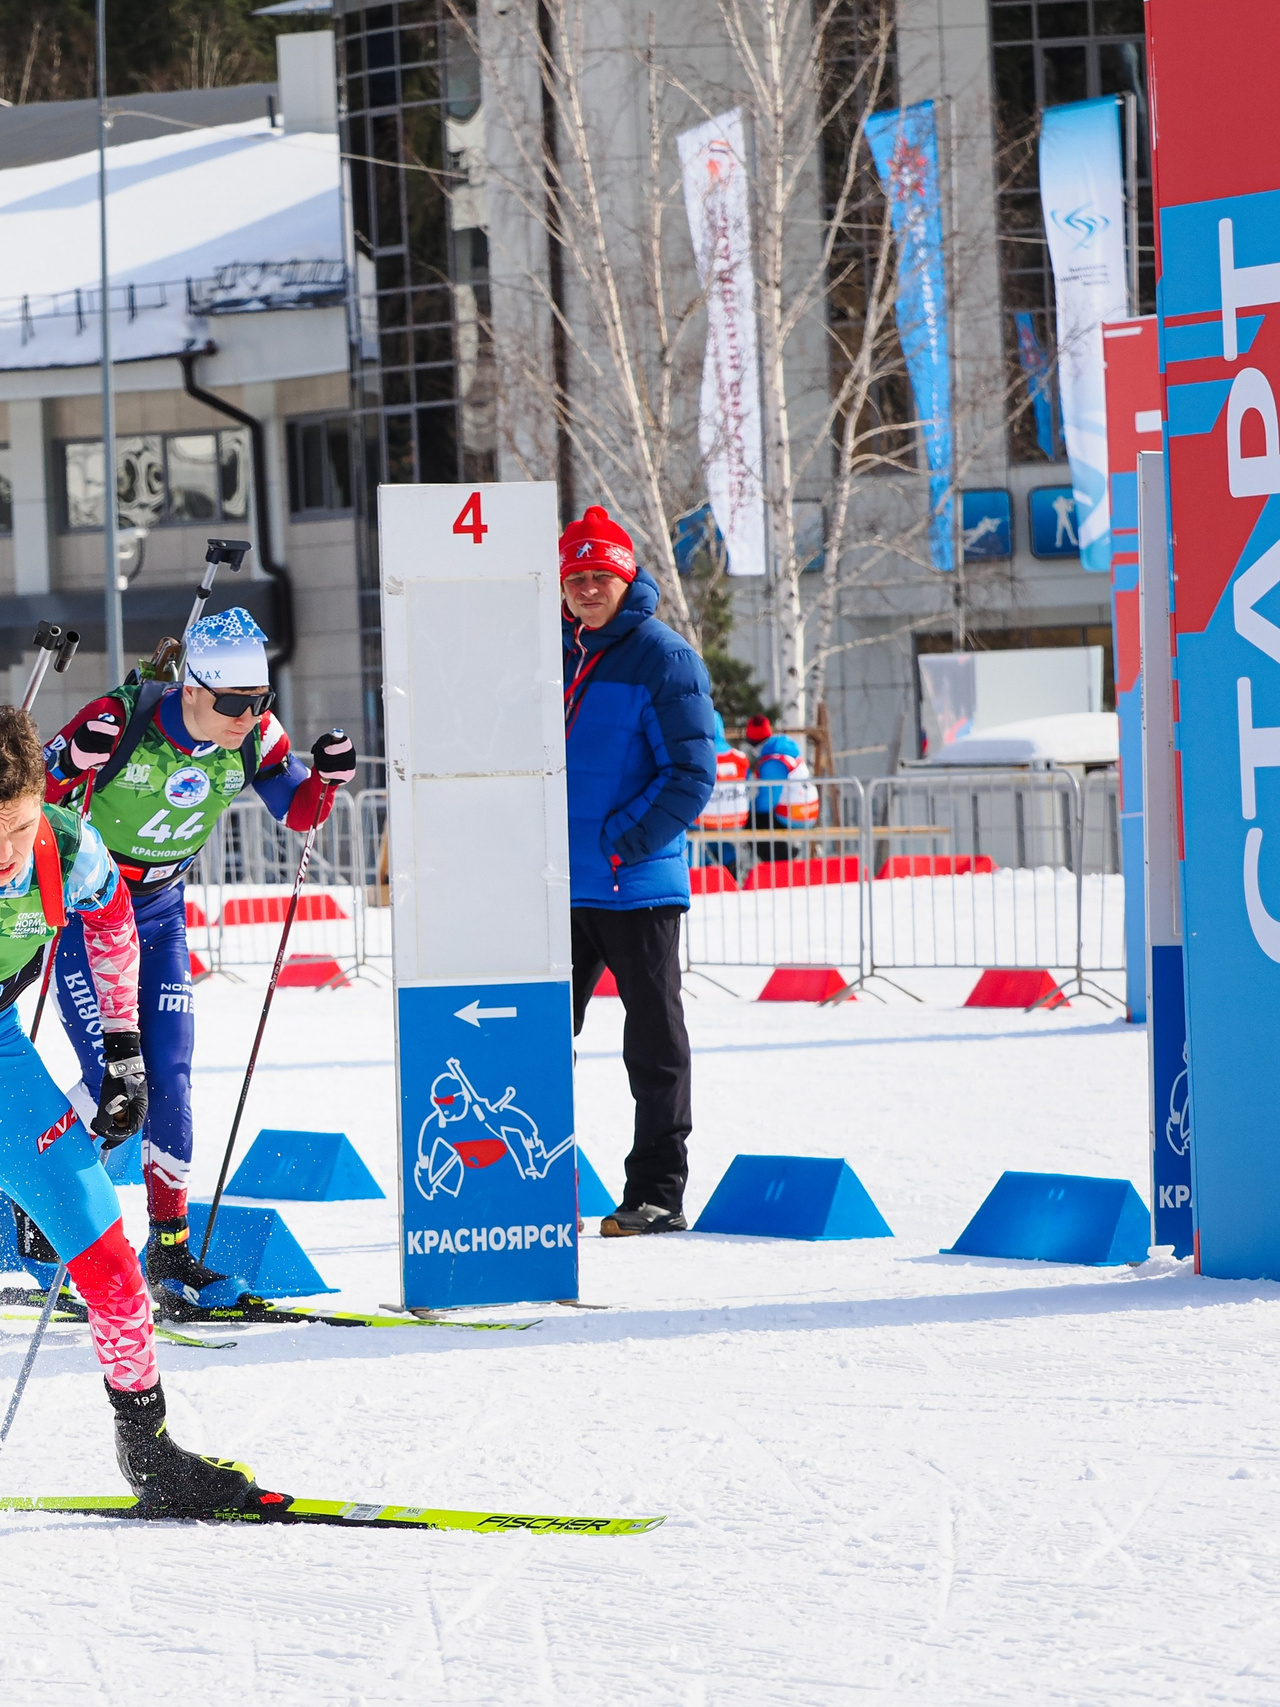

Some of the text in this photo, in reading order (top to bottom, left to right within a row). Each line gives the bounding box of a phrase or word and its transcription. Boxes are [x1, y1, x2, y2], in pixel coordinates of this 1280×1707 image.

[452, 491, 488, 545] 4
[136, 808, 206, 844] 44
[130, 845, 194, 858] КРАСНОЯРСК
[407, 1223, 573, 1255] КРАСНОЯРСК
[209, 1310, 244, 1318] FISCHER
[133, 1391, 158, 1407] 193
[214, 1512, 261, 1521] FISCHER
[476, 1514, 612, 1532] FISCHER
